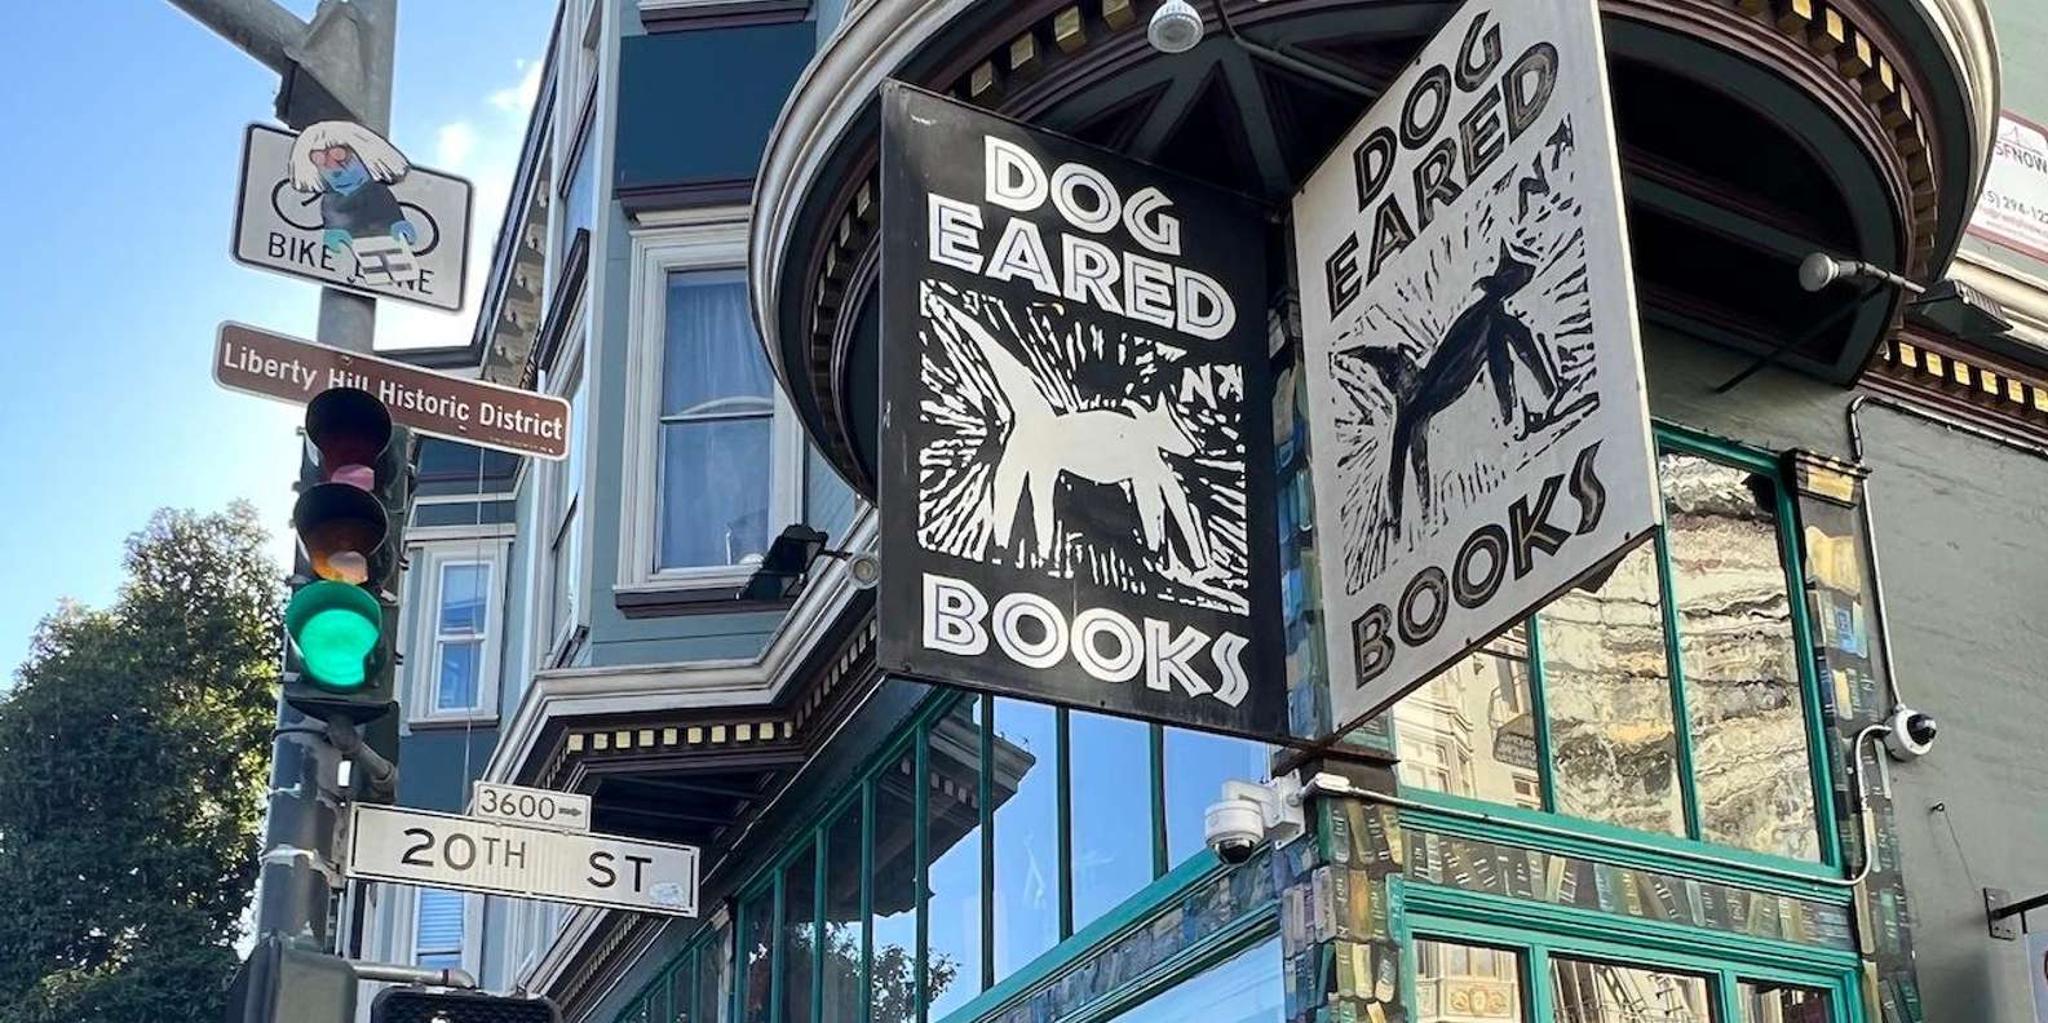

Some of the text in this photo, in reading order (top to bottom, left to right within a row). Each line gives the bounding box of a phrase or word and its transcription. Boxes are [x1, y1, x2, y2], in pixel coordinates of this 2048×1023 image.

[1353, 10, 1502, 213] DOG
[983, 135, 1181, 256] DOG
[1325, 41, 1559, 322] EARED
[268, 231, 336, 272] BIKE
[928, 193, 1237, 341] EARED
[224, 342, 563, 440] Liberty Hill Historic District
[1351, 439, 1606, 689] BOOKS
[922, 572, 1251, 708] BOOKS
[401, 827, 653, 893] 20TH ST
[481, 789, 556, 821] 3600
